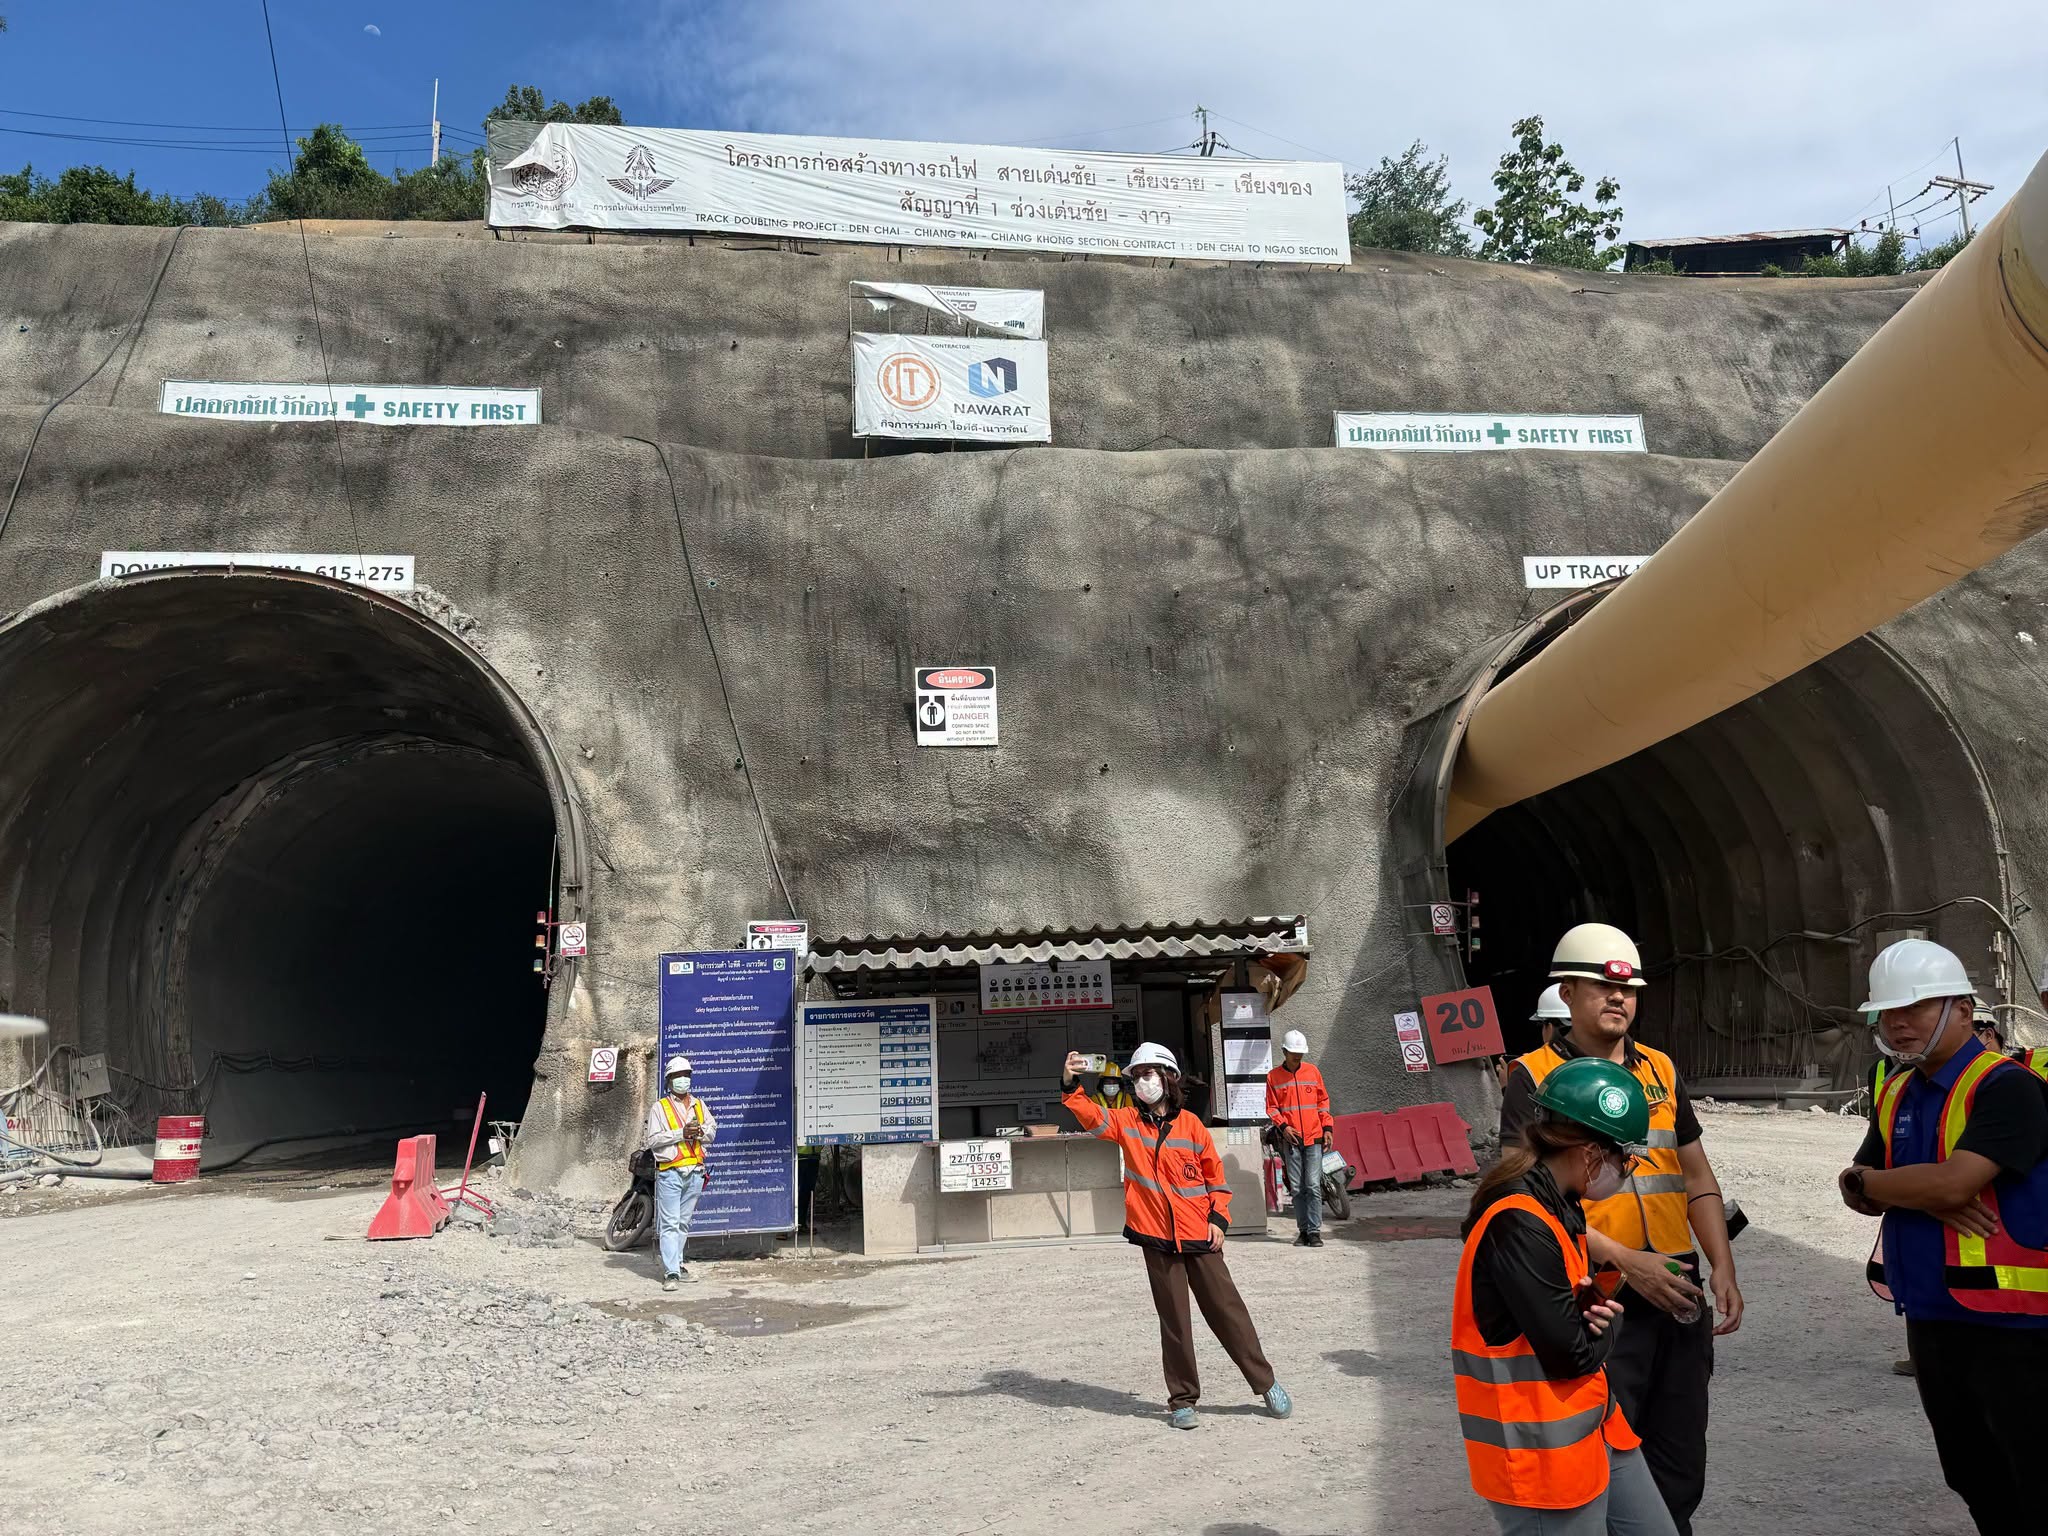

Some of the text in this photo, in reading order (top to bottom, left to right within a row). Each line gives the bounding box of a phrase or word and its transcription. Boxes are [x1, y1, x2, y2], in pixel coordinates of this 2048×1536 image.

[725, 144, 977, 180] โครงการก่อสร้างทางรถไฟ
[997, 163, 1096, 186] สายเด่นชัย
[1127, 167, 1205, 191] เชียงราย
[1234, 172, 1312, 196] เชียงของ
[899, 188, 979, 218] สัญญาที่
[1010, 196, 1107, 222] ช่วงเด่นชัย
[1138, 209, 1171, 224] งาว
[695, 213, 729, 224] TRACK
[734, 216, 788, 228] DOUBLING
[793, 220, 837, 232] PROJECT
[849, 224, 869, 233] DEN
[874, 225, 900, 235] CHAI
[915, 228, 956, 239] CHIANG
[960, 230, 977, 240] RAI
[991, 232, 1032, 243] CHIANG
[1037, 234, 1074, 245] KHONG
[1078, 236, 1119, 248] SECTION
[1124, 239, 1175, 250] CONTRACT
[1196, 242, 1216, 252] DEN
[1220, 243, 1244, 253] CHAI
[1248, 244, 1260, 253] TO
[1264, 245, 1295, 255] NGAO
[1299, 246, 1338, 256] SECTION
[175, 394, 337, 417] ปลอดภัยไว้ก่อน
[383, 401, 526, 421] SAFETY FIRST
[954, 402, 1031, 417] NAWARAT
[881, 419, 947, 431] กิจการร่วมค้า
[1348, 424, 1481, 443] ปลอดภัยไว้ก่อน
[1518, 428, 1632, 444] SAFETY FIRST
[1535, 564, 1632, 579] UP TRACK
[937, 673, 975, 684] อันตราย
[1436, 998, 1485, 1034] 20
[883, 1116, 895, 1124] 68
[909, 1116, 921, 1124] 68
[970, 1162, 999, 1175] 1359
[974, 1178, 998, 1187] 1425
